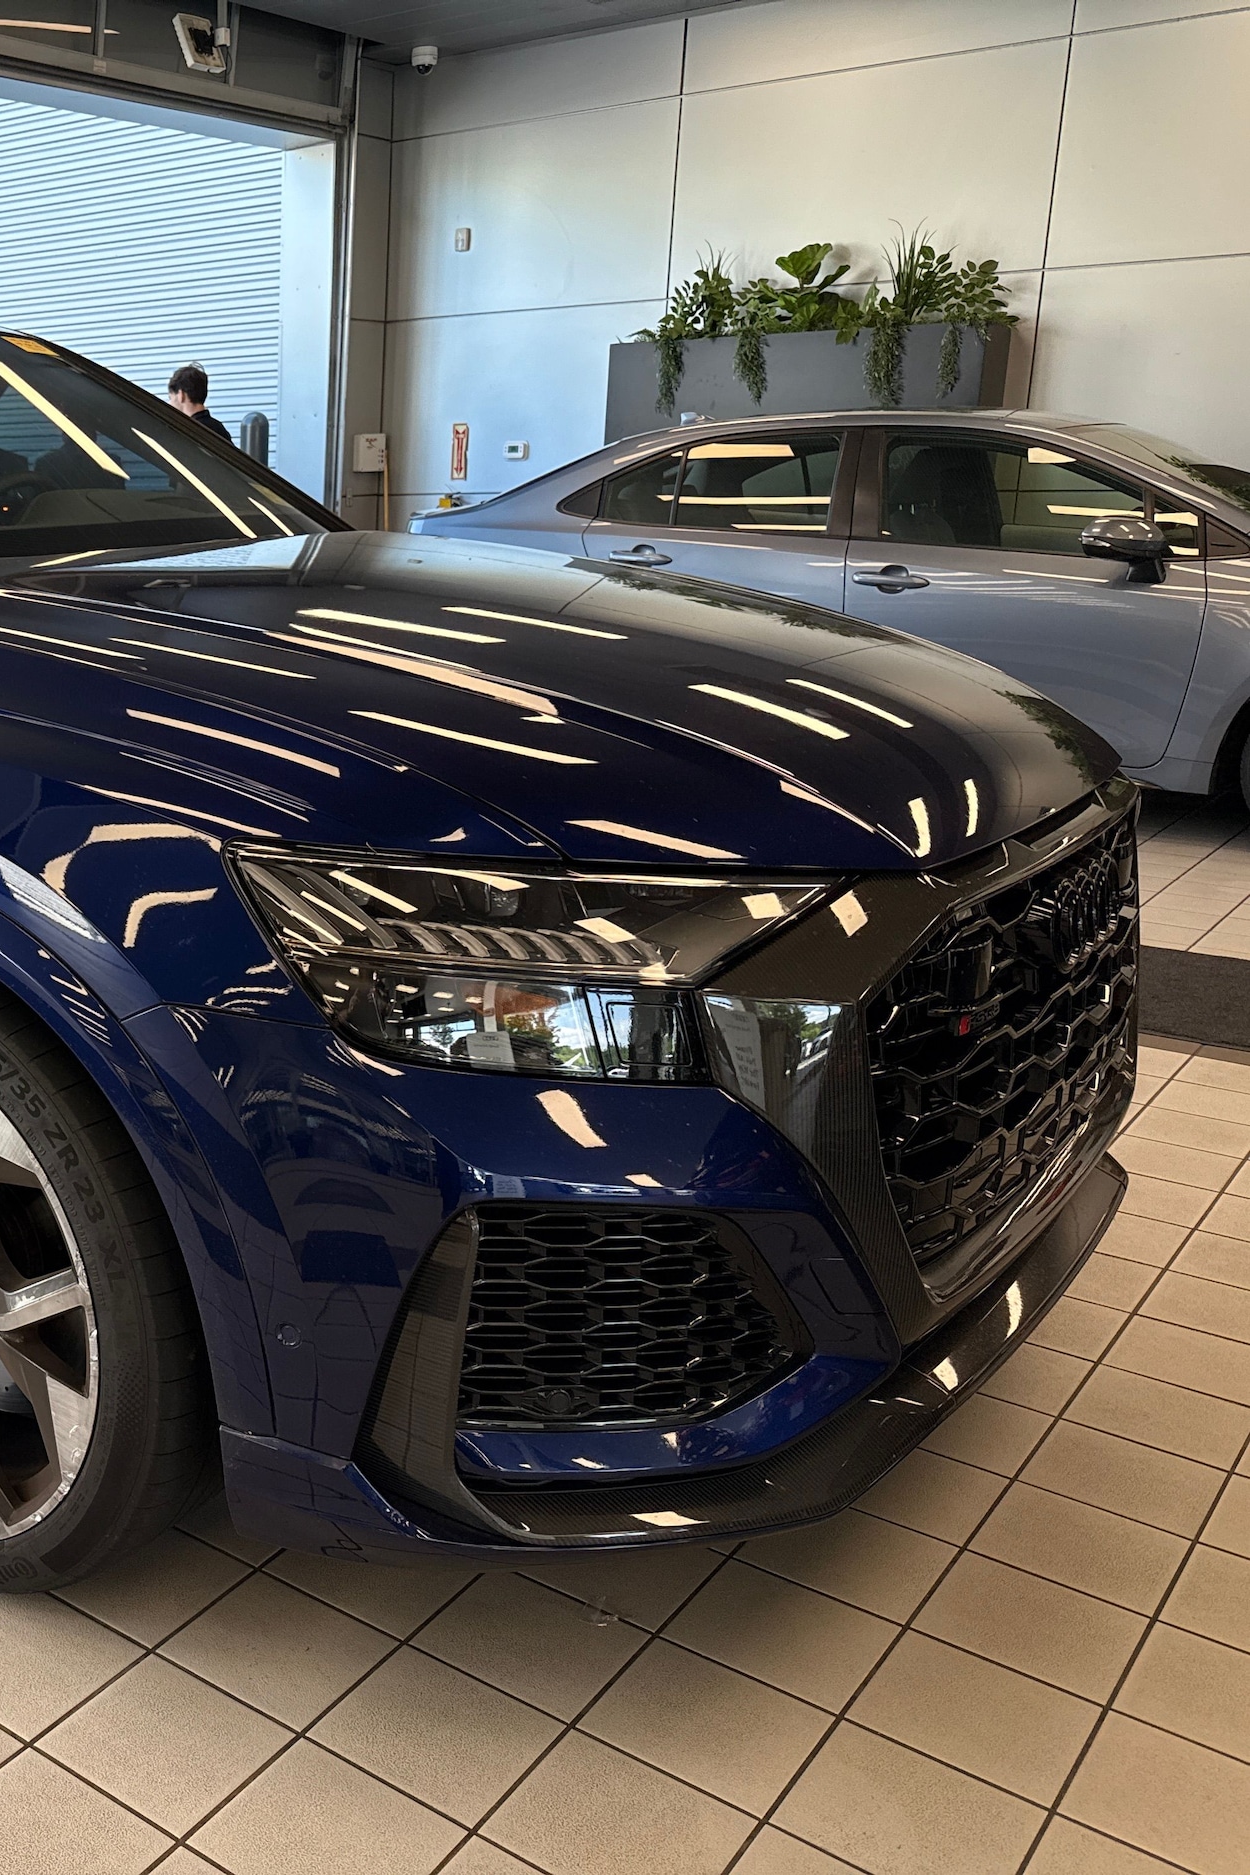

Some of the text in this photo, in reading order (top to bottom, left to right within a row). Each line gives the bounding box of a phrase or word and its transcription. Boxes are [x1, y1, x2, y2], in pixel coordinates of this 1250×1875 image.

[43, 1122, 80, 1174] ZR
[72, 1176, 105, 1225] 23
[101, 1239, 126, 1292] XL
